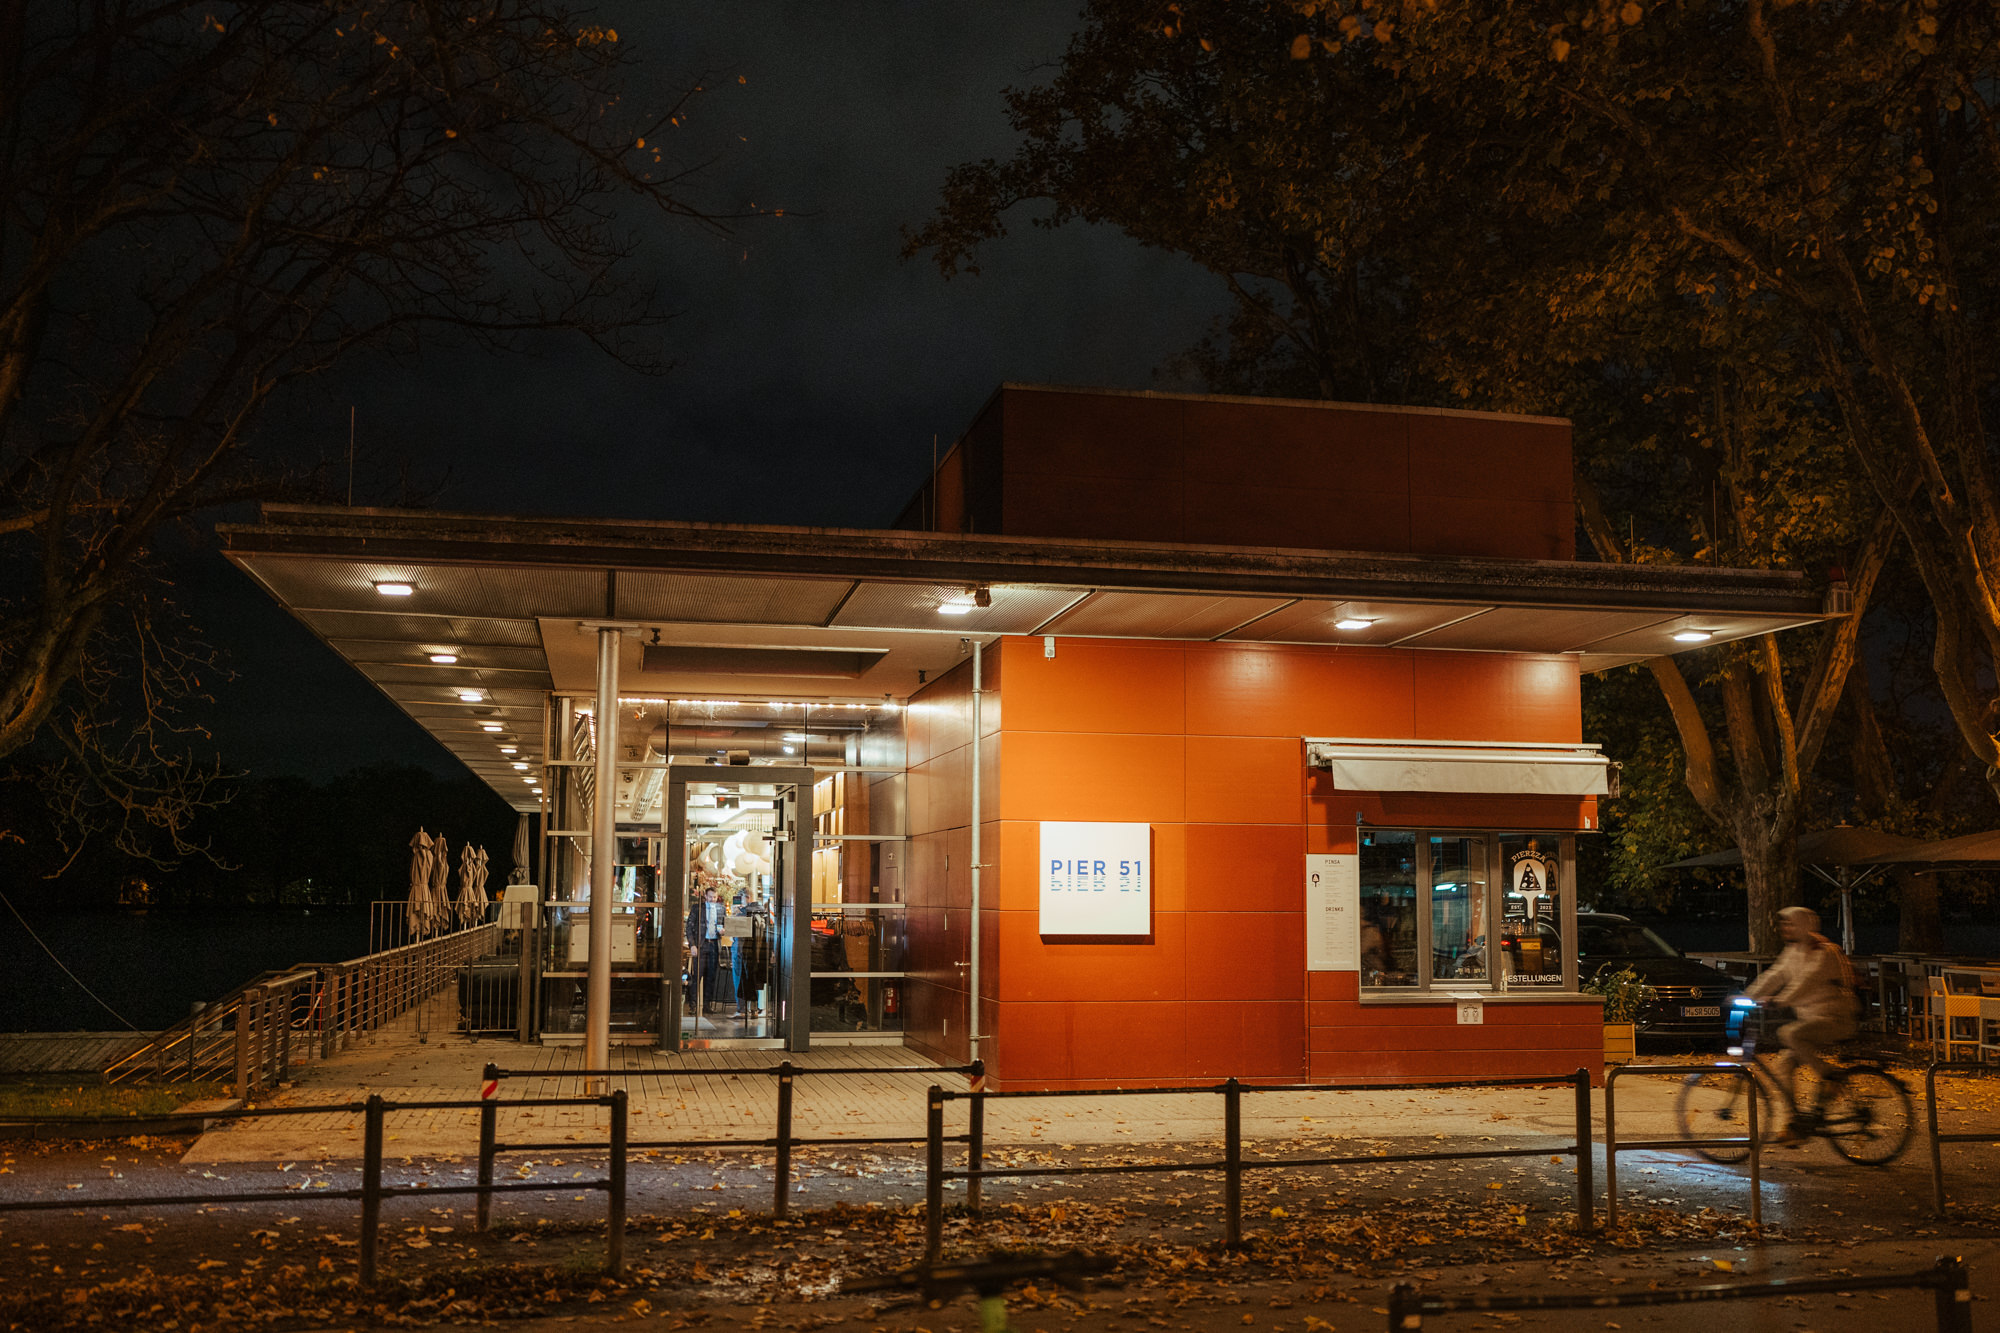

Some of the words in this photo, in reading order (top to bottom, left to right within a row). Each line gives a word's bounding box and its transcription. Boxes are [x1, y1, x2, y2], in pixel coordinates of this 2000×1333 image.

[1511, 850, 1546, 863] PIERZZA
[1051, 859, 1106, 876] PIER
[1119, 860, 1142, 876] 51
[1505, 974, 1562, 982] ESTELLUNGEN
